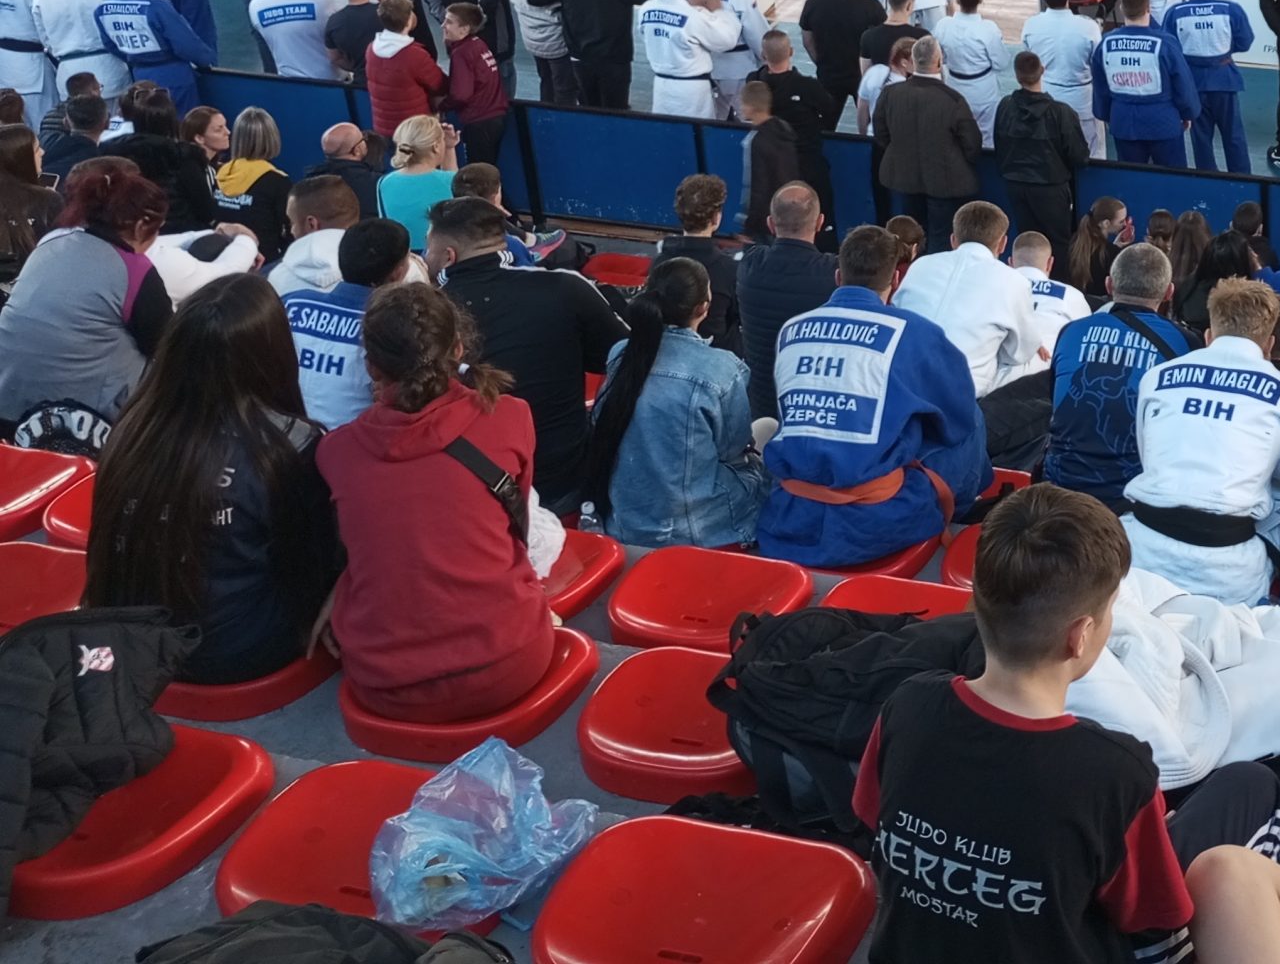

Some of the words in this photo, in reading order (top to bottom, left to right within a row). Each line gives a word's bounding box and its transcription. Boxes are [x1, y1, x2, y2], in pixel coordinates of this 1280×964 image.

[1194, 21, 1214, 30] BIH
[1121, 57, 1141, 67] BIH
[786, 322, 880, 345] M.HALILOVIĆ
[1083, 326, 1121, 345] JUDO
[300, 348, 346, 376] BIH
[795, 356, 845, 378] BIH
[1162, 367, 1207, 386] EMIN
[1210, 369, 1278, 399] MAGLIC
[785, 407, 838, 425] ŽEPČE
[1182, 397, 1236, 422] BIH
[896, 811, 947, 845] JUDO
[955, 836, 1011, 866] KLUB
[901, 886, 978, 928] MOSTAR
